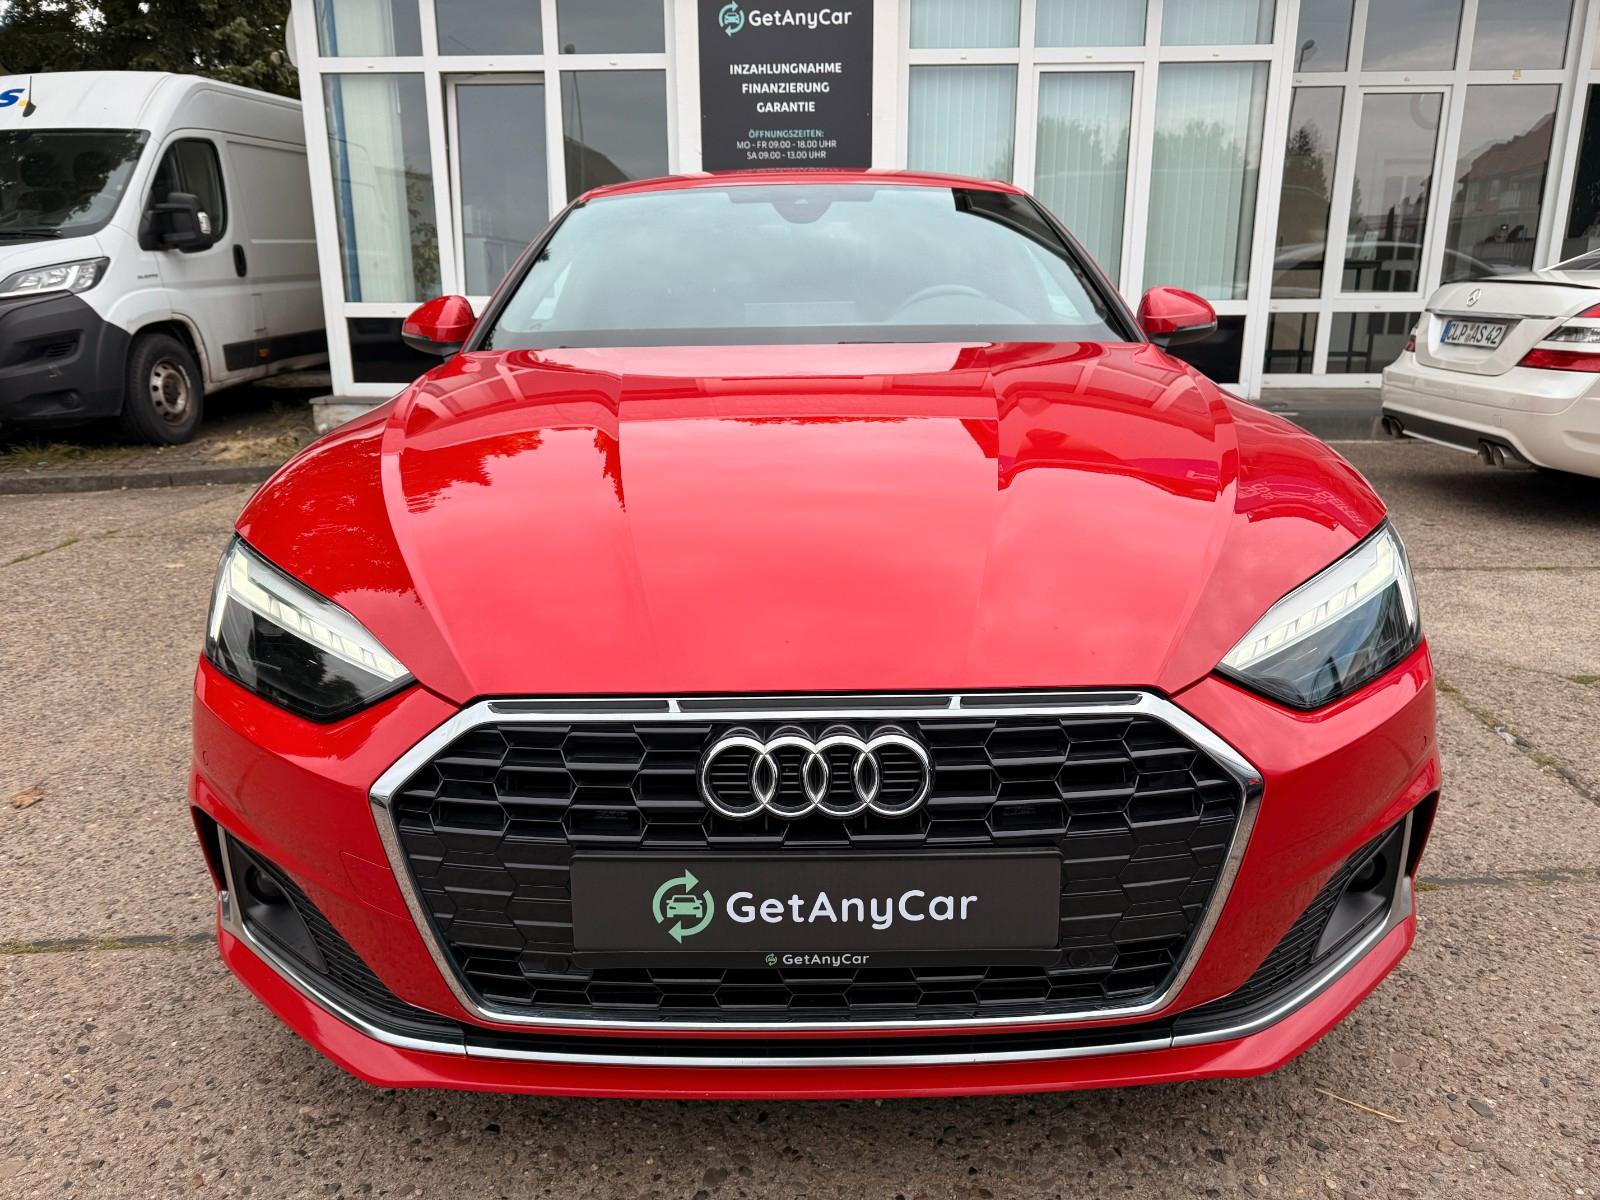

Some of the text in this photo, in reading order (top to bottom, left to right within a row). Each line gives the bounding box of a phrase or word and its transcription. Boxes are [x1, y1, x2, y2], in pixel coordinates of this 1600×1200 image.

[749, 9, 852, 29] GetAnyCar
[729, 62, 842, 75] INZAHLUNGNAHME
[742, 81, 830, 94] FINANZIERUNG
[756, 101, 816, 113] GARANTIE
[748, 128, 825, 138] ÖFFNUNGSZEITEN:
[736, 141, 751, 149] MO
[757, 141, 767, 149] FR
[819, 140, 837, 148] UHR
[746, 151, 757, 159] SA
[808, 151, 826, 159] UHR
[726, 889, 978, 931] GetAnyCar
[782, 953, 870, 967] GetAnyCar
